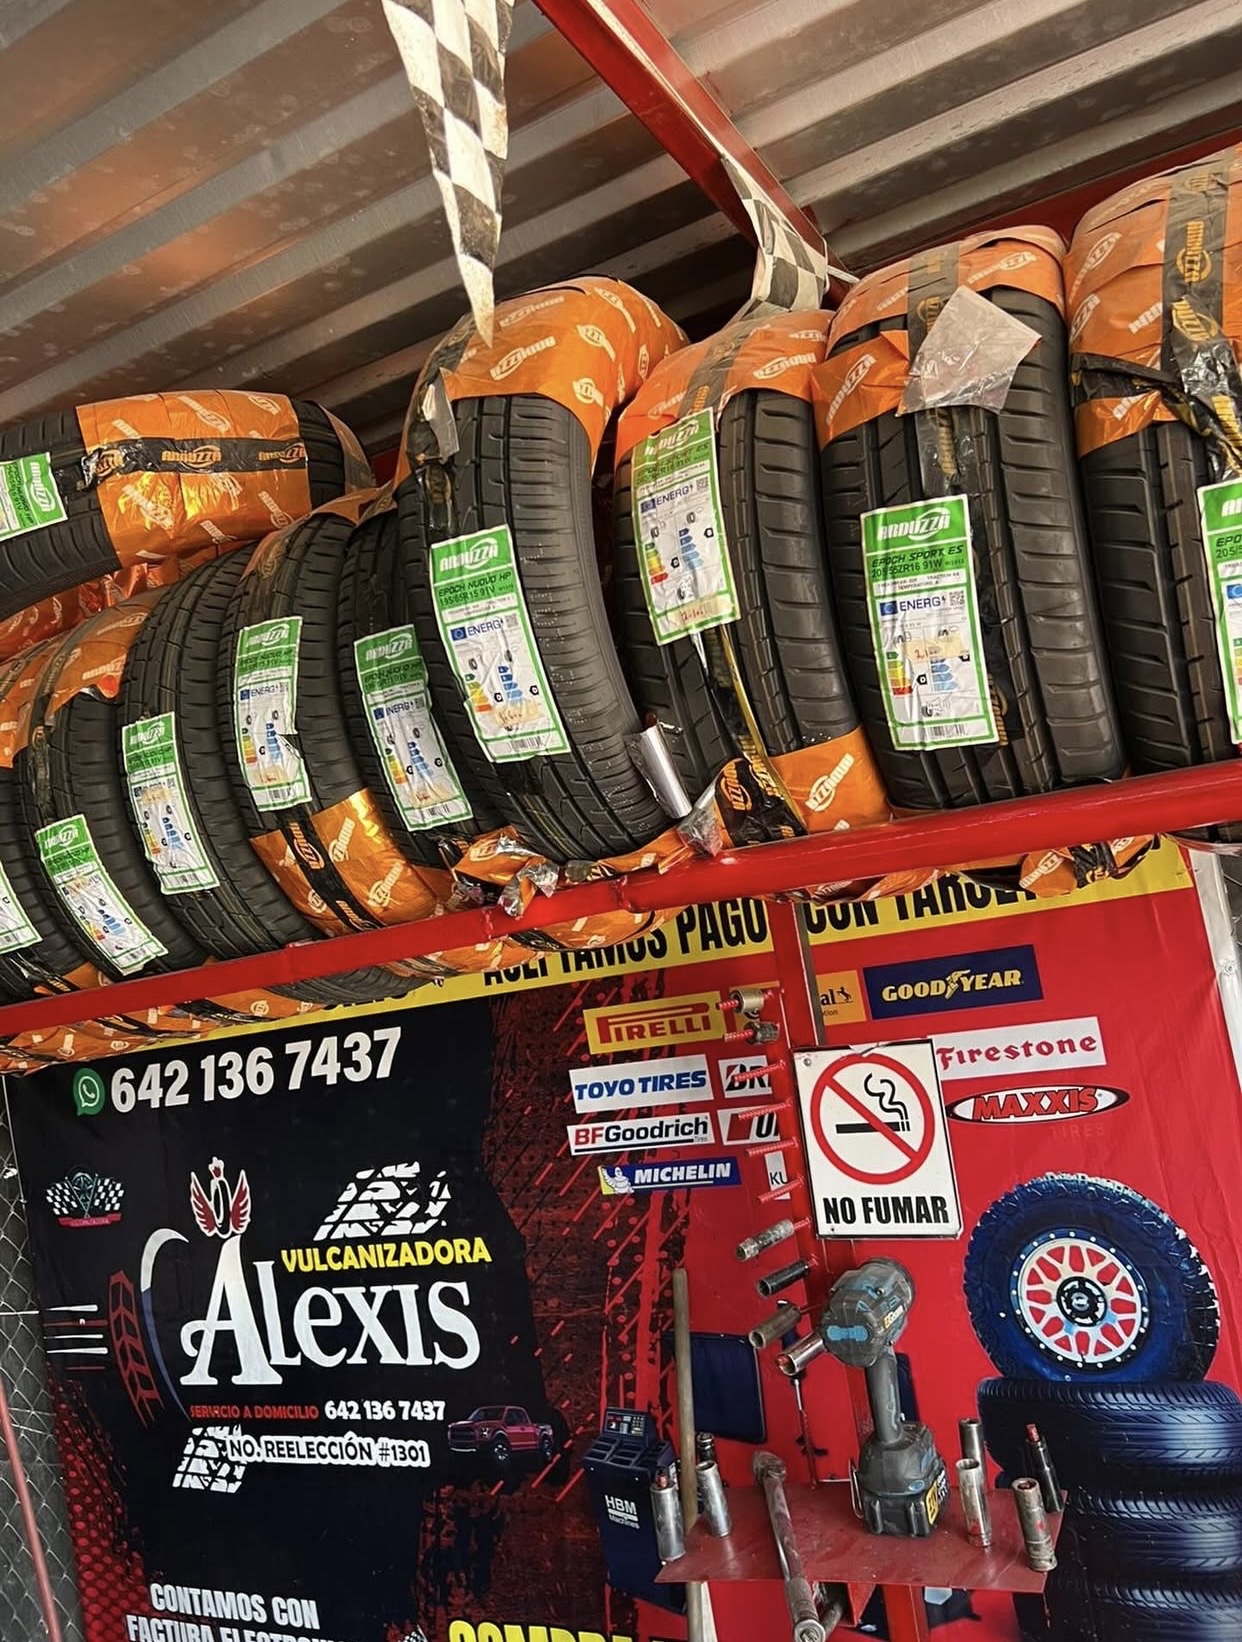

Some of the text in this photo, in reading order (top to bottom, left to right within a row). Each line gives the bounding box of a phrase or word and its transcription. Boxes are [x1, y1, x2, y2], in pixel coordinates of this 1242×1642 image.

[876, 506, 952, 542] ARDUZZA
[438, 538, 499, 573] ARDUZZA
[596, 1002, 711, 1044] PIRELLI
[110, 1026, 402, 1113] 642 136 7437
[936, 1035, 1098, 1071] Firestone
[575, 1079, 635, 1100] TOYO
[638, 1070, 707, 1093] TIRES
[971, 1087, 1098, 1121] MAXXIS
[574, 1116, 709, 1146] BFGoodrich
[634, 1162, 731, 1184] MICHELIN
[823, 1196, 949, 1225] NO FUMAR
[281, 1236, 492, 1274] VULCANIZADORA
[190, 1400, 446, 1421] SERVICIO A DOMICILIO 642 136 7437
[266, 1433, 373, 1462] REELECCIÓN
[378, 1441, 428, 1463] #1301
[605, 1494, 637, 1515] HBM
[150, 1582, 320, 1630] CONTAMOS CON
